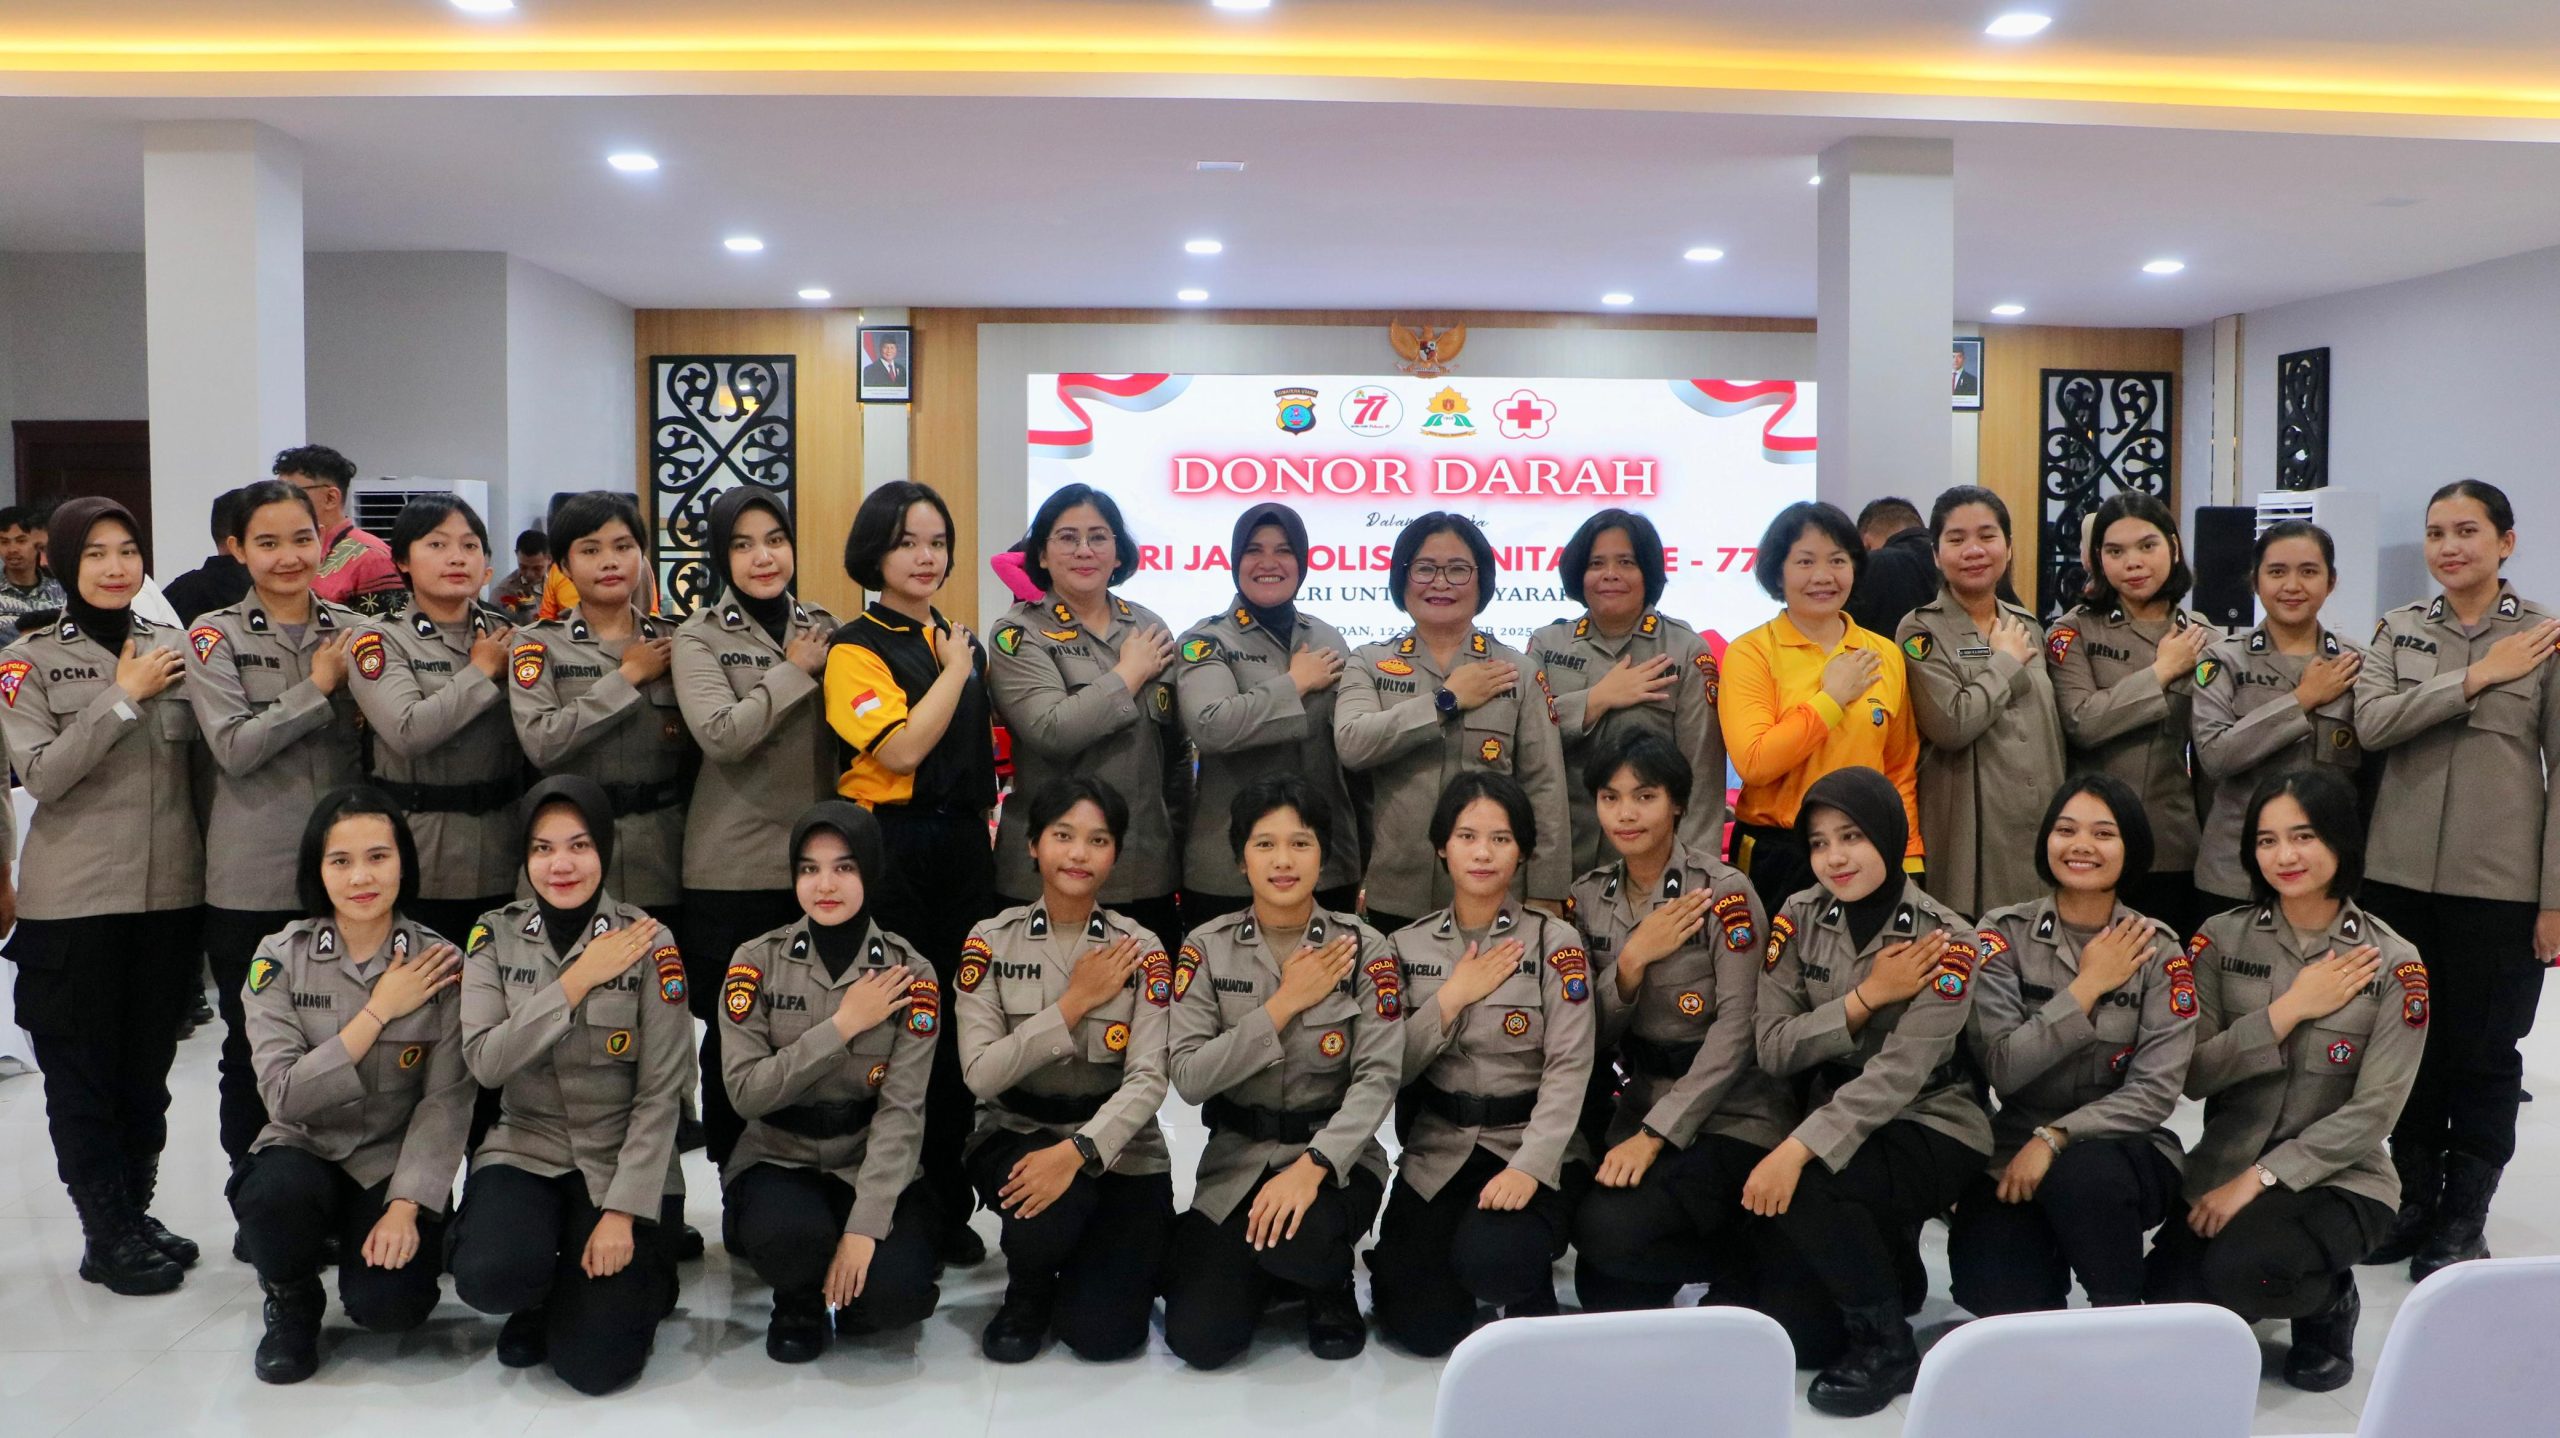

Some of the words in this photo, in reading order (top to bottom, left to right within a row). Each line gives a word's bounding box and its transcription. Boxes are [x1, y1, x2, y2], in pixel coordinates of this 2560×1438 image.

[1173, 457, 1413, 494] DONOR
[1433, 457, 1656, 496] DARAH
[1138, 545, 1172, 570] RI
[1184, 545, 1232, 571] JA
[1308, 545, 1392, 571] OLIS
[1490, 546, 1565, 571] NITA
[1663, 547, 1678, 571] E
[1717, 547, 1759, 572] 77
[1293, 587, 1332, 601] LRI
[1340, 587, 1390, 601] UNT
[1336, 626, 1374, 637] DAN,
[1380, 627, 1394, 636] 12
[1500, 627, 1533, 637] 2025
[2393, 635, 2437, 655] RIZA
[720, 653, 753, 667] QORI
[755, 656, 771, 668] NF
[50, 667, 98, 681] OCHA
[2236, 671, 2278, 687] ELLY
[1714, 894, 1745, 913] POLDA
[655, 946, 679, 961] POLDA
[1551, 947, 1583, 964] POLDA
[1949, 944, 1975, 958] OLDA
[1143, 952, 1168, 968] POLDA
[1368, 960, 1395, 974] POLDA
[514, 967, 536, 984] AYU
[993, 961, 1041, 980] RUTH
[910, 981, 937, 993] POLDA
